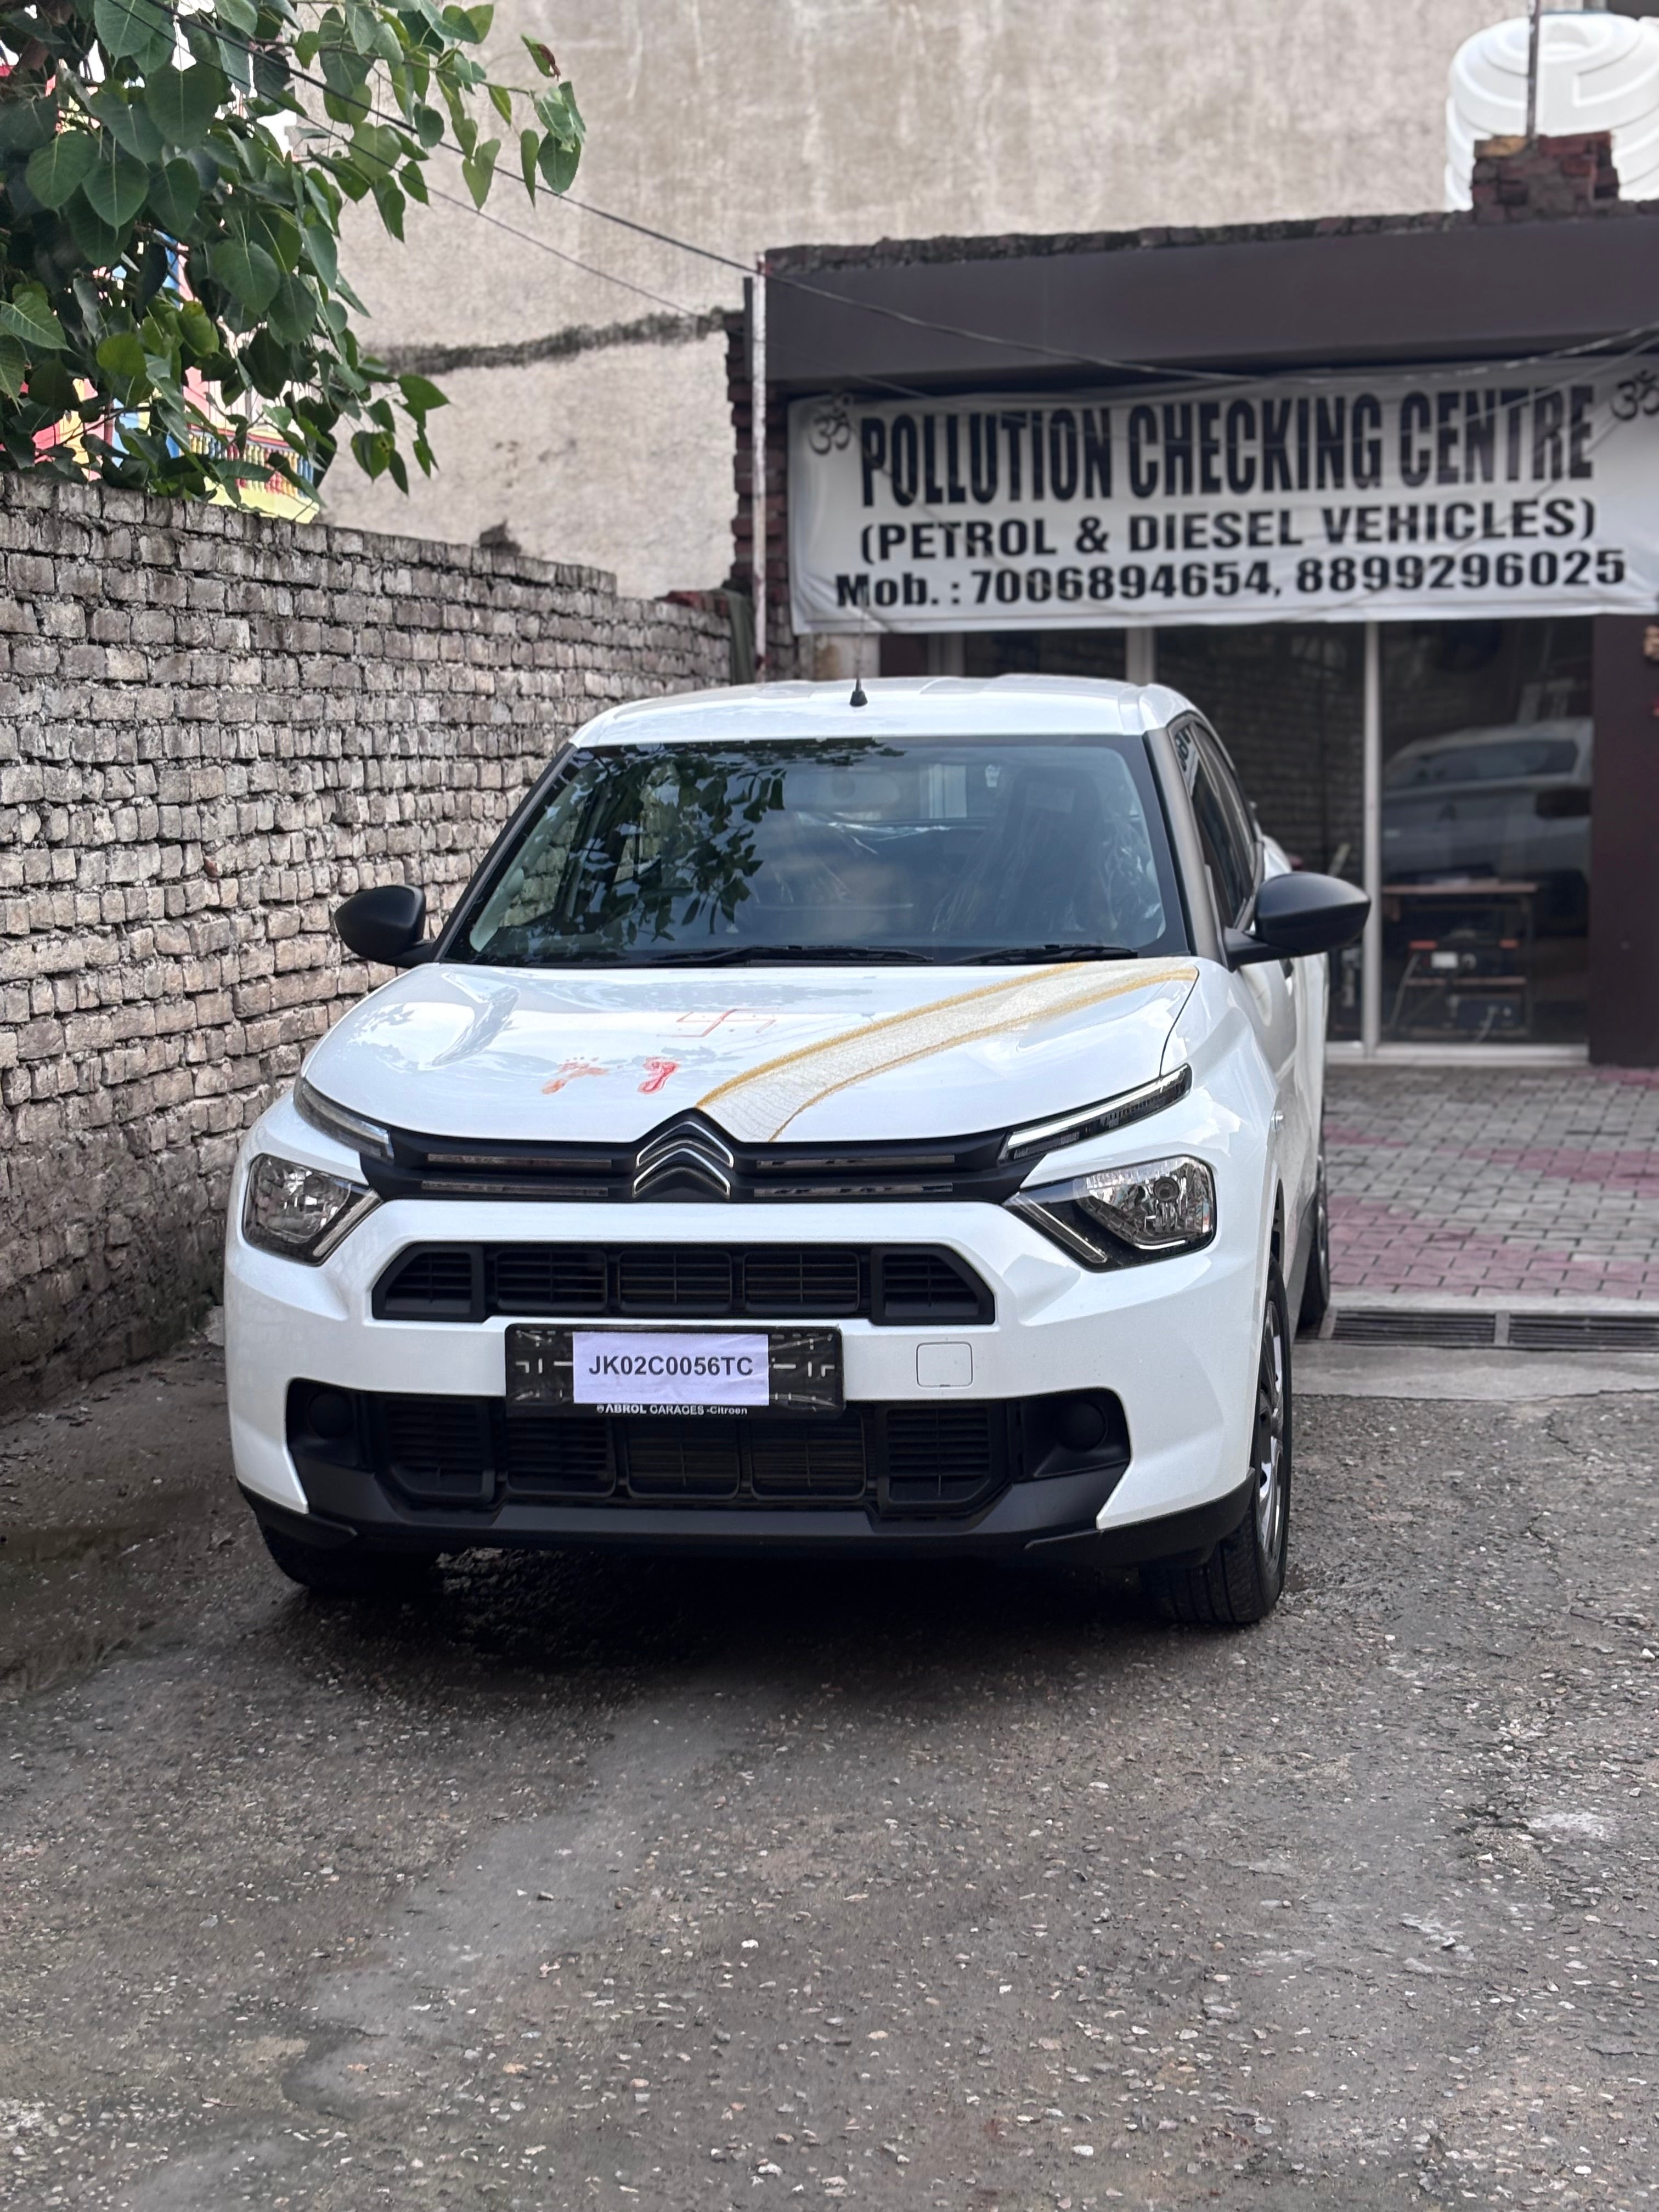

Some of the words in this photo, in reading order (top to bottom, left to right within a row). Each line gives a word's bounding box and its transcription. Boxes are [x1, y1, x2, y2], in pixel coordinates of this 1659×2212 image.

[860, 407, 1113, 507] POLLUTION
[1128, 393, 1383, 499] CHECKING
[1399, 385, 1595, 488] CENTRE
[861, 518, 1058, 565] (PETROL
[1075, 516, 1109, 554] &
[1129, 510, 1304, 552] DIESEL
[1322, 498, 1596, 544] VEHICLES)
[970, 561, 1282, 605] 7006894654,
[1295, 549, 1626, 594] 8899296025
[588, 1355, 753, 1376] JK02C0056TC
[605, 1403, 647, 1414] ABROL
